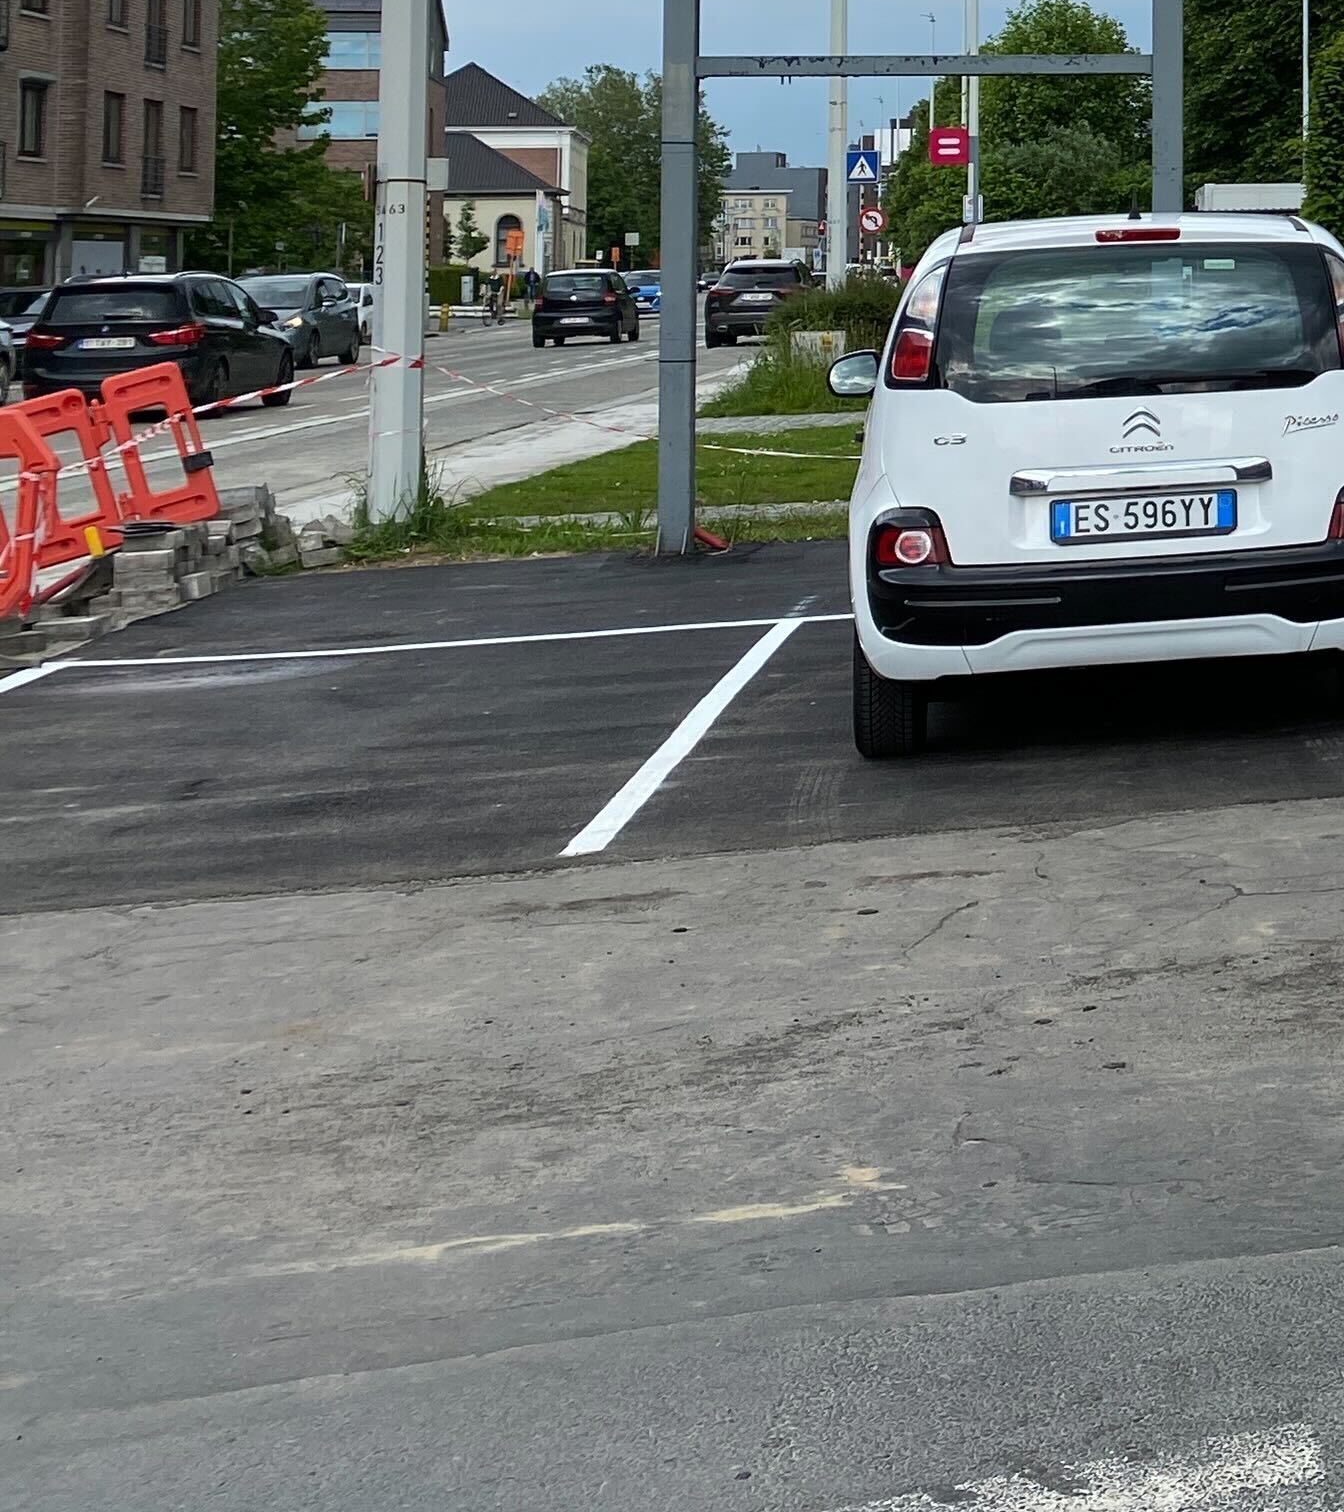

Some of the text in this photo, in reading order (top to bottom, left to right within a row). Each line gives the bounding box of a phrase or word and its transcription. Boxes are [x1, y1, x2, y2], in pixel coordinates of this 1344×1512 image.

[1281, 413, 1339, 438] Picasso
[934, 433, 968, 446] C3
[1075, 496, 1213, 533] ES 596YY
